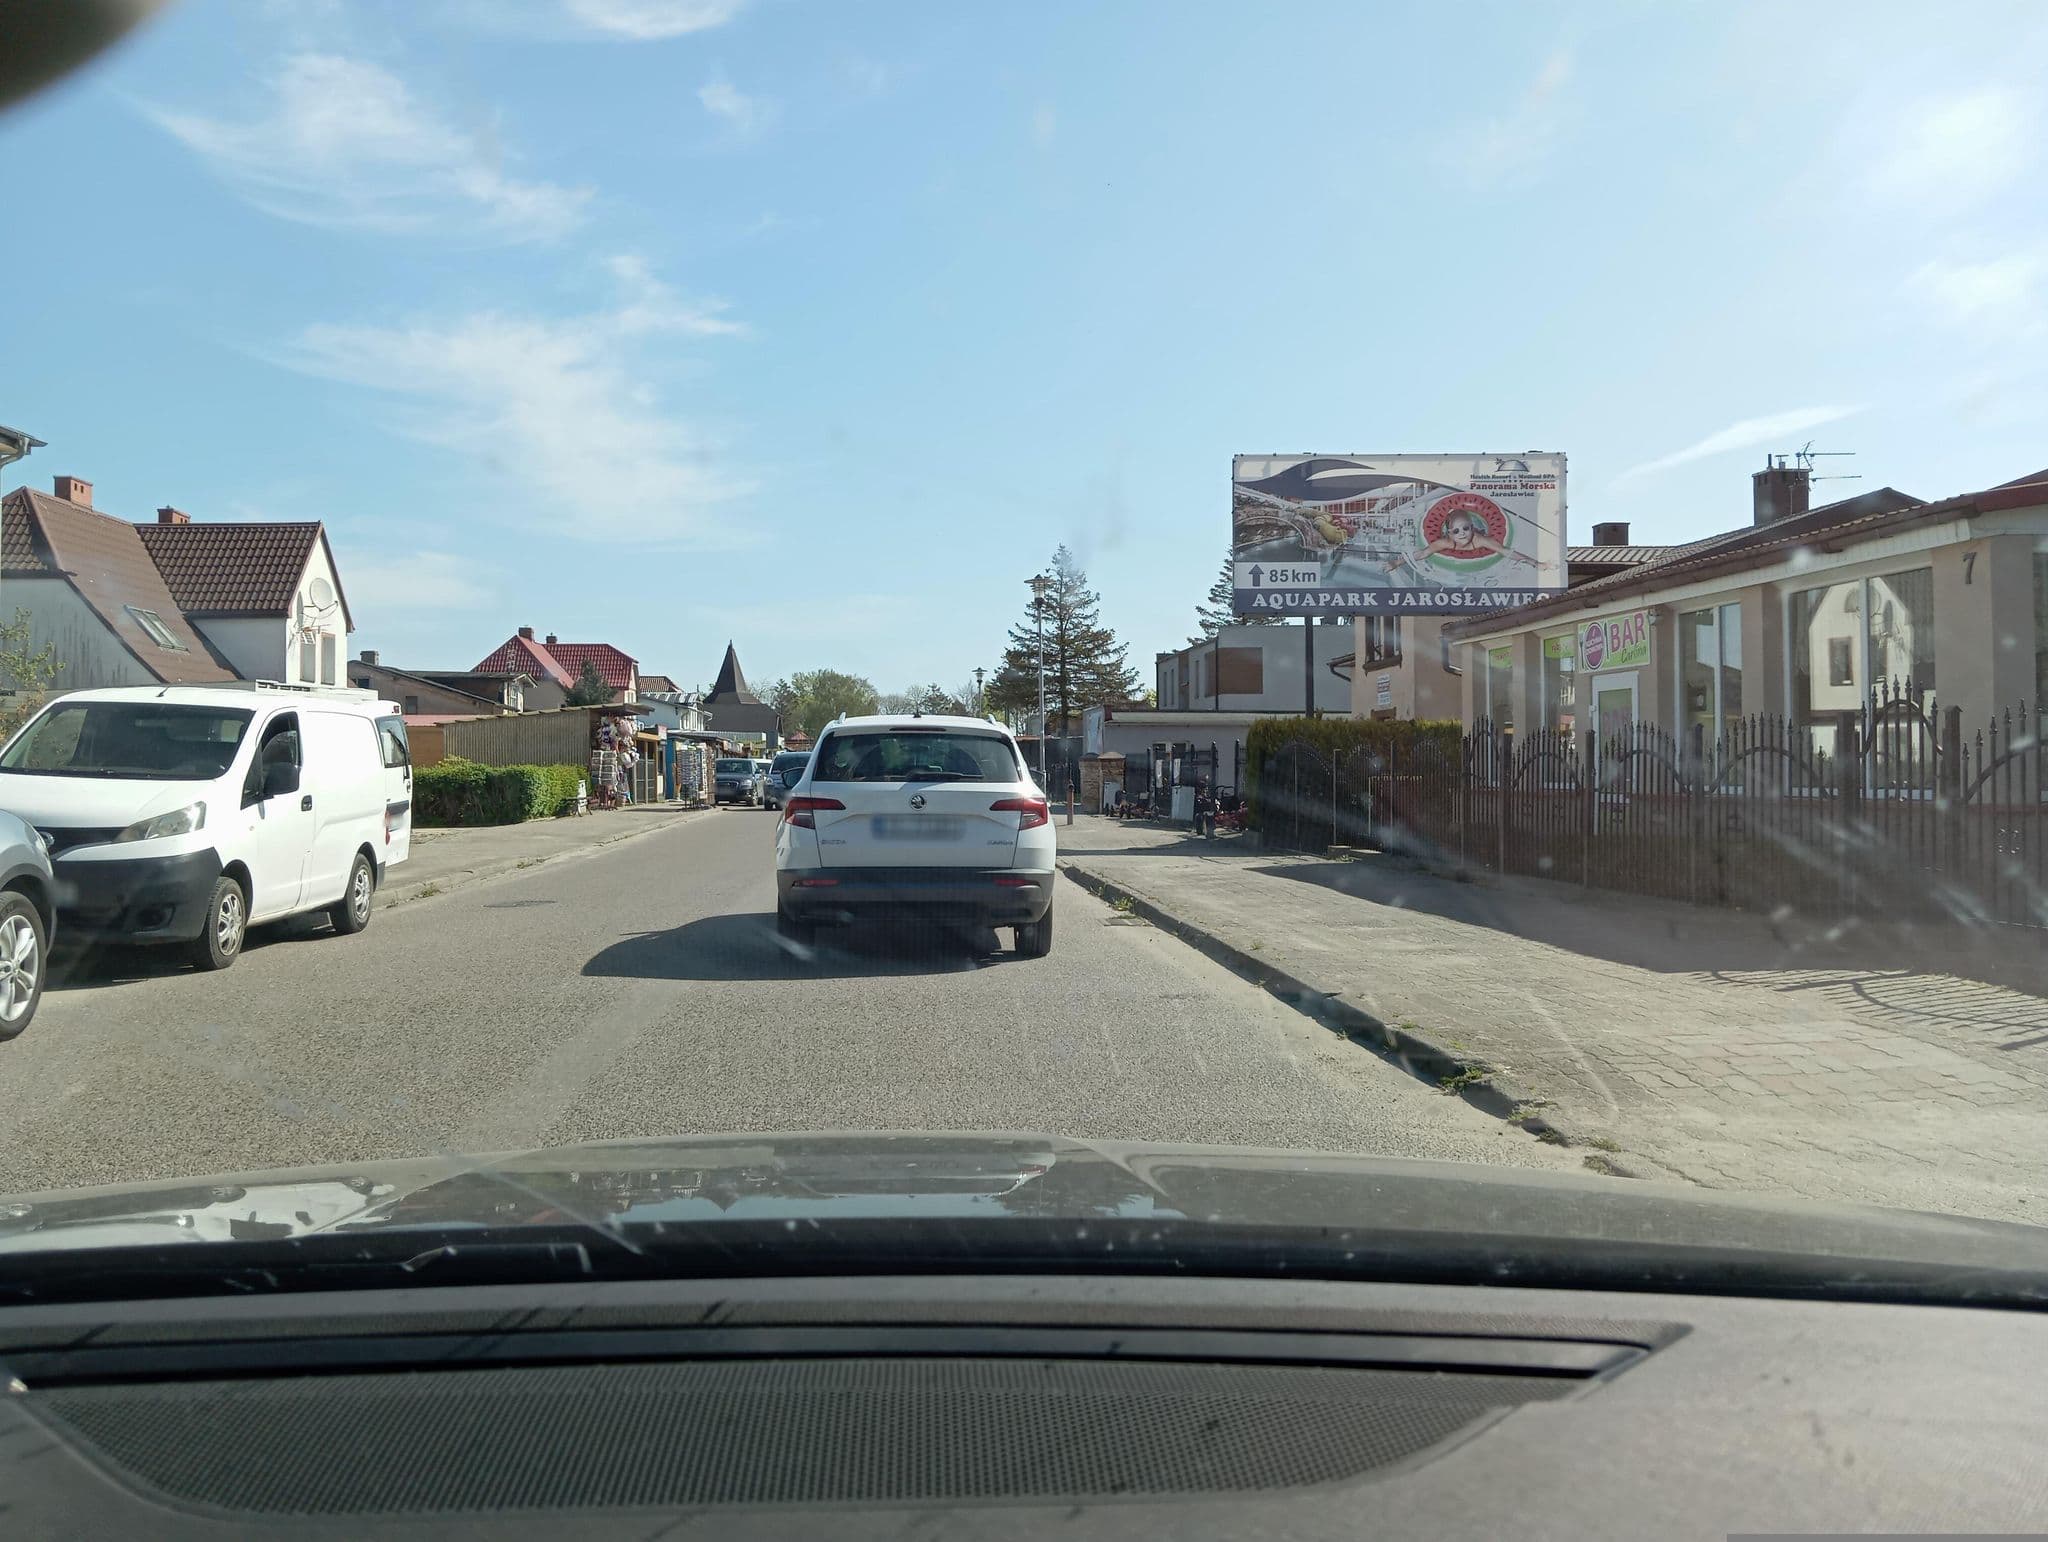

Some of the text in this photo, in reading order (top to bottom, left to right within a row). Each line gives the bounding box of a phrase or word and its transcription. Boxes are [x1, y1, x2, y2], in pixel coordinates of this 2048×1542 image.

[1963, 551, 1978, 585] 7
[1252, 592, 1379, 609] AQUAPARK
[1610, 612, 1646, 653] BAR
